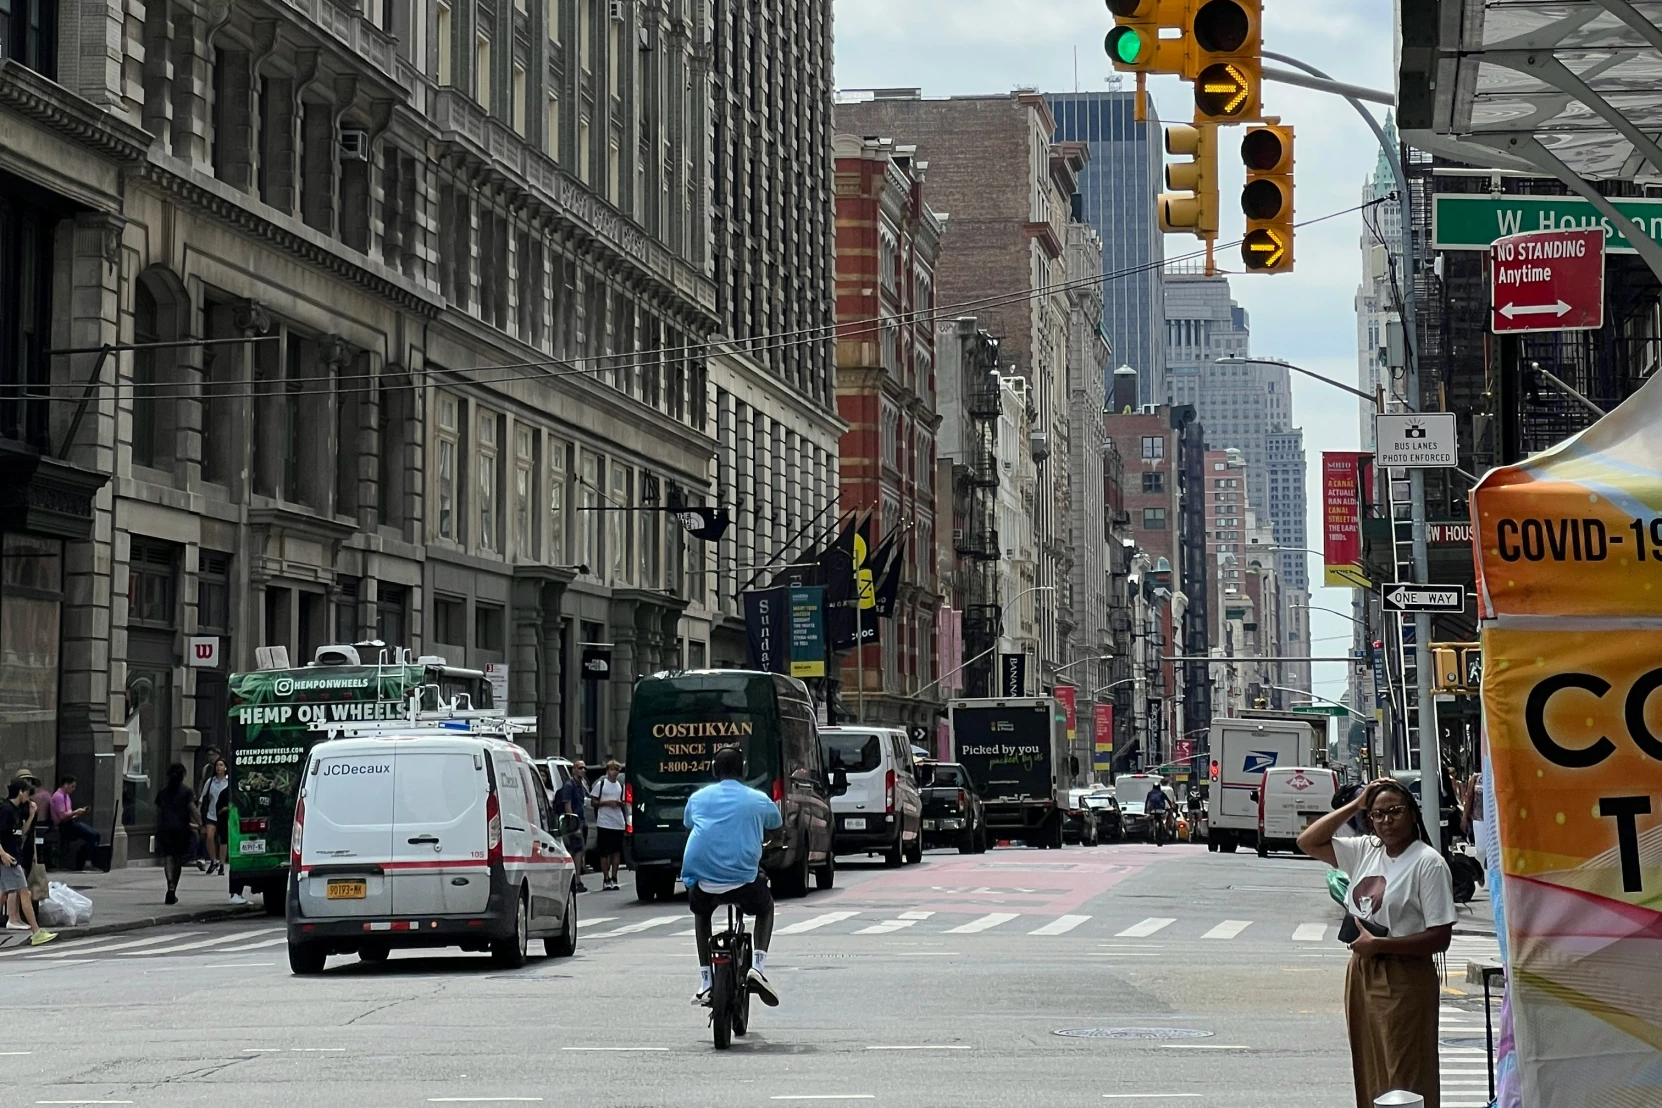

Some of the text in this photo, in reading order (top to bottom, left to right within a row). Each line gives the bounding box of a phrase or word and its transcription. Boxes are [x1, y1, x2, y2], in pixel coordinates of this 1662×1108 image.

[1496, 209, 1523, 236] W
[1497, 240, 1586, 262] NO STANDING
[1498, 264, 1552, 287] Anytime
[1394, 442, 1438, 450] BUS LANES
[1382, 454, 1451, 463] PHOTO ENFORCED
[1328, 497, 1342, 505] RAN
[1328, 506, 1349, 514] CANAL
[1329, 524, 1341, 532] THE
[1430, 526, 1440, 541] W
[1395, 592, 1453, 604] ONE WAY
[1009, 657, 1018, 697] BANANA
[294, 678, 369, 690] HEMPONWHEELS
[239, 703, 407, 725] HEMP ON WHEELS
[652, 722, 753, 738] COSTIKYAN
[664, 743, 706, 755] "SINCE
[962, 744, 1040, 756] Picked by you
[235, 754, 299, 765] 845.821.9949
[989, 754, 1020, 770] packed
[323, 764, 390, 776] JCDecaux
